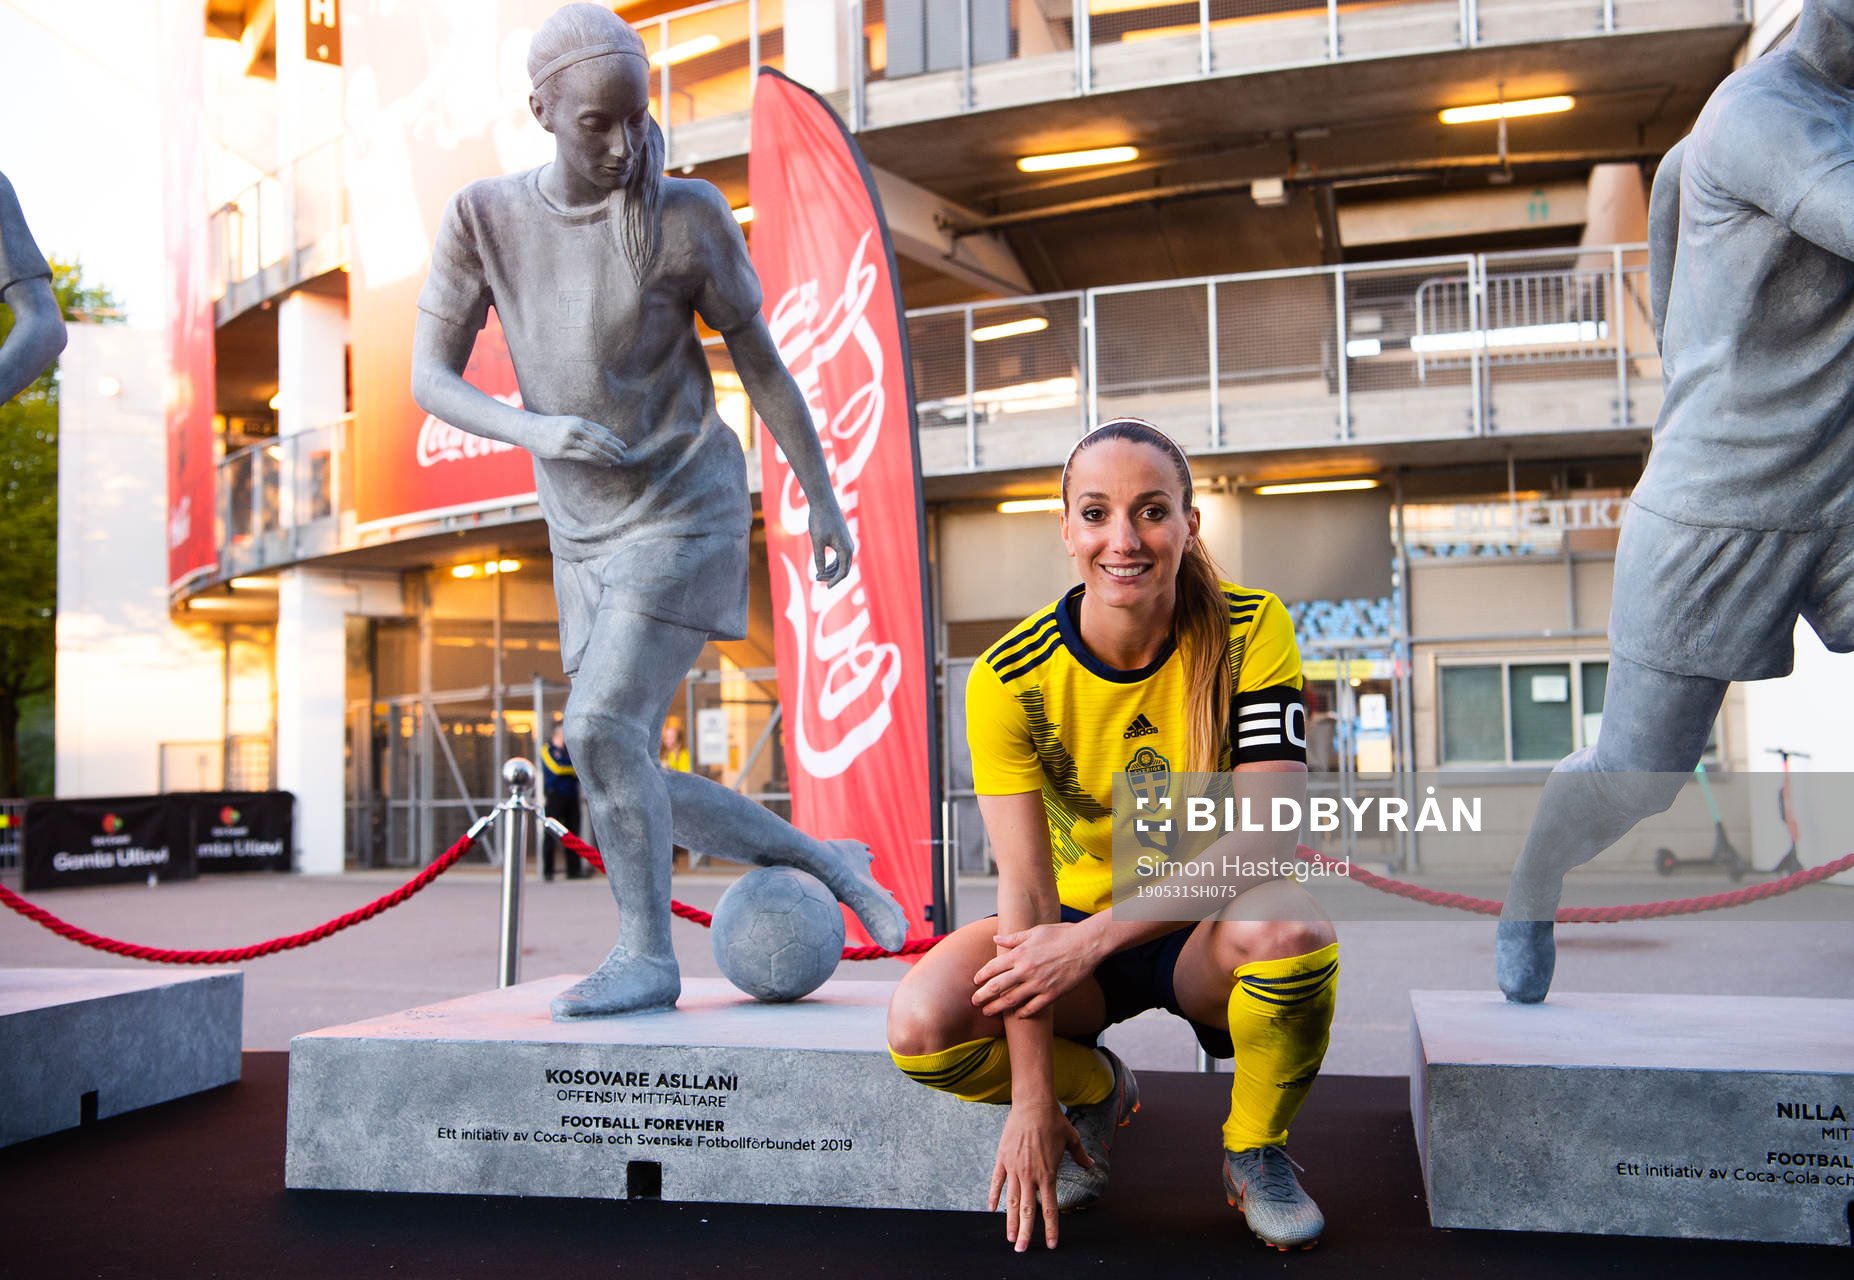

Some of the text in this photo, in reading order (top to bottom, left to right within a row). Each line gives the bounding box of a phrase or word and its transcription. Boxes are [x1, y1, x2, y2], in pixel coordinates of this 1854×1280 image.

[1122, 725, 1159, 740] adidas
[53, 847, 169, 872] Gamla Ullevi
[545, 1069, 738, 1091] KOSOVARE ASLLANI
[557, 1089, 727, 1108] OFFENSIV MITTFÄLTARE
[1777, 1103, 1847, 1122] NILLA
[561, 1115, 725, 1132] FOOTBALL FOREVHER
[437, 1127, 853, 1151] Ett initiativ av Coca-Cola och Svenska Fotbollförbundet 2019
[1821, 1127, 1854, 1141] MIT
[1616, 1163, 1640, 1176] Ett
[1646, 1164, 1703, 1178] initiativ
[1709, 1168, 1728, 1180] av
[1734, 1168, 1820, 1184] Coca-Cola
